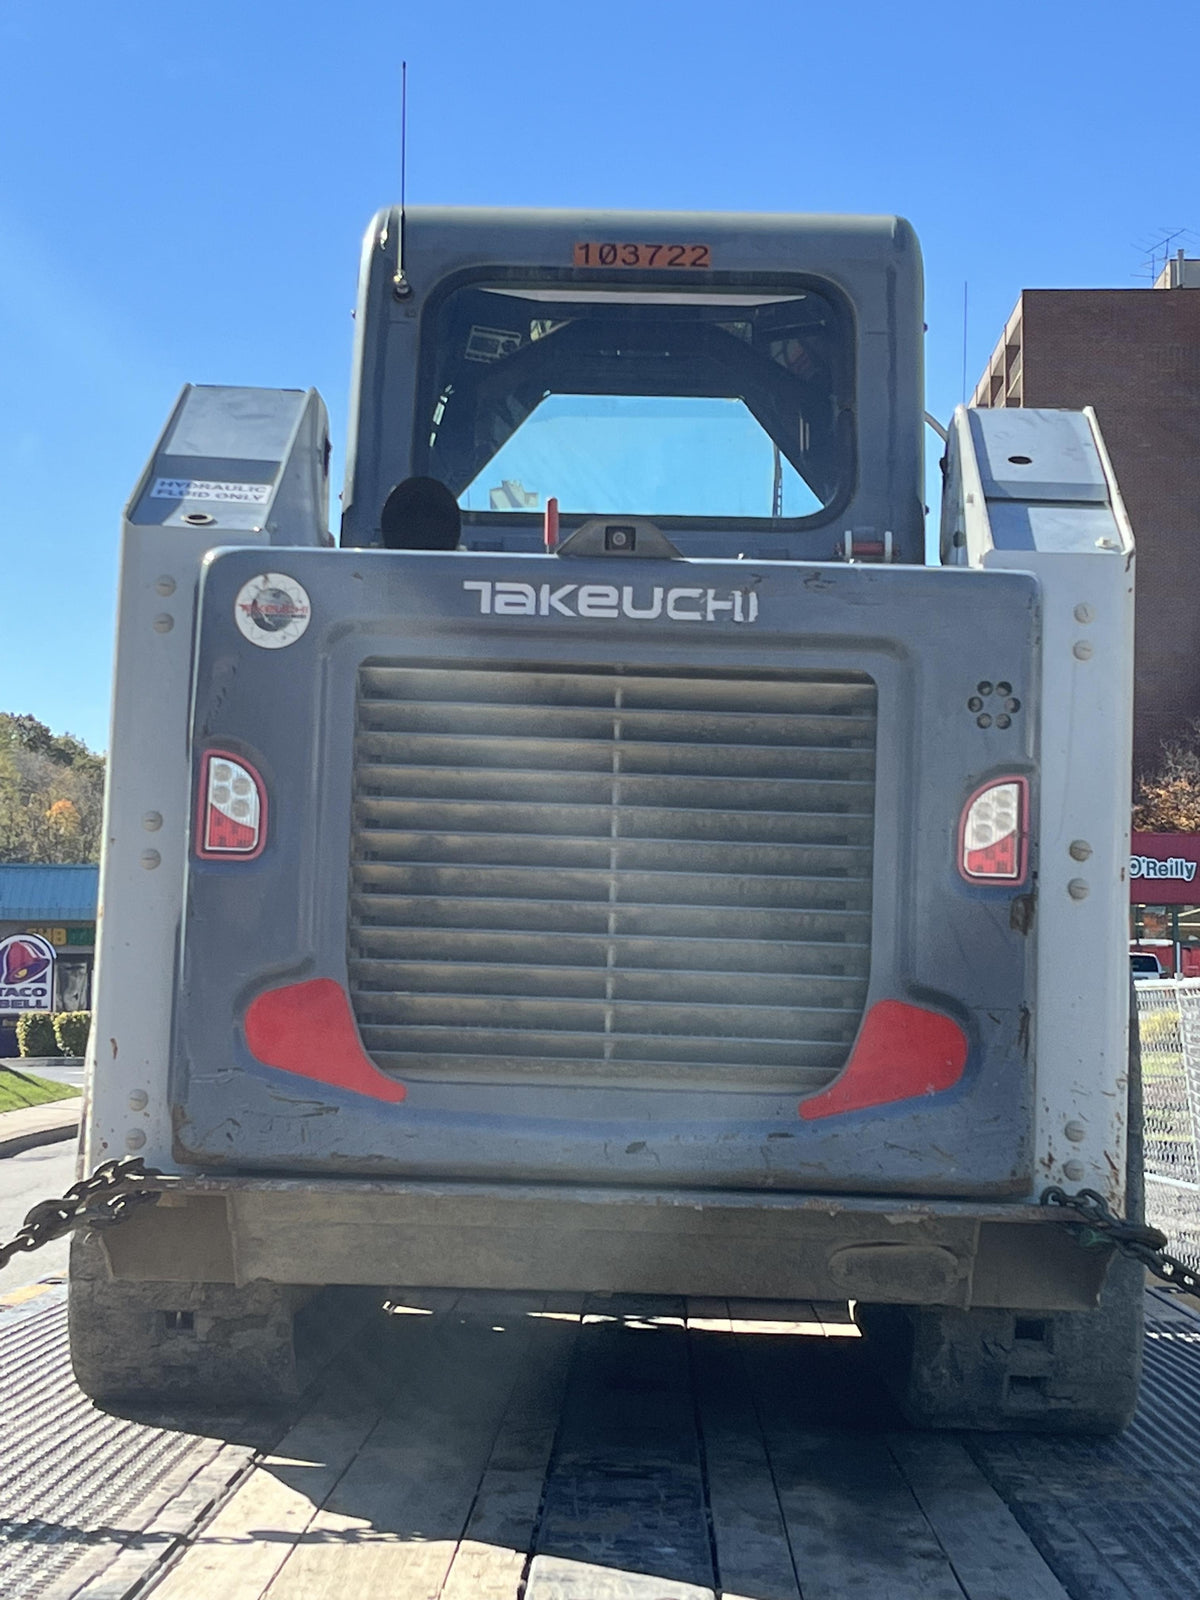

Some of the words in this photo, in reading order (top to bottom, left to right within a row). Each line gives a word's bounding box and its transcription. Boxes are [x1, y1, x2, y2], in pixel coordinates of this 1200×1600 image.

[578, 243, 709, 268] 103722
[157, 489, 210, 498] FLUID
[215, 491, 265, 501] ONLY
[160, 480, 267, 492] HYDRAULIC
[1130, 856, 1195, 880] O'Reilly
